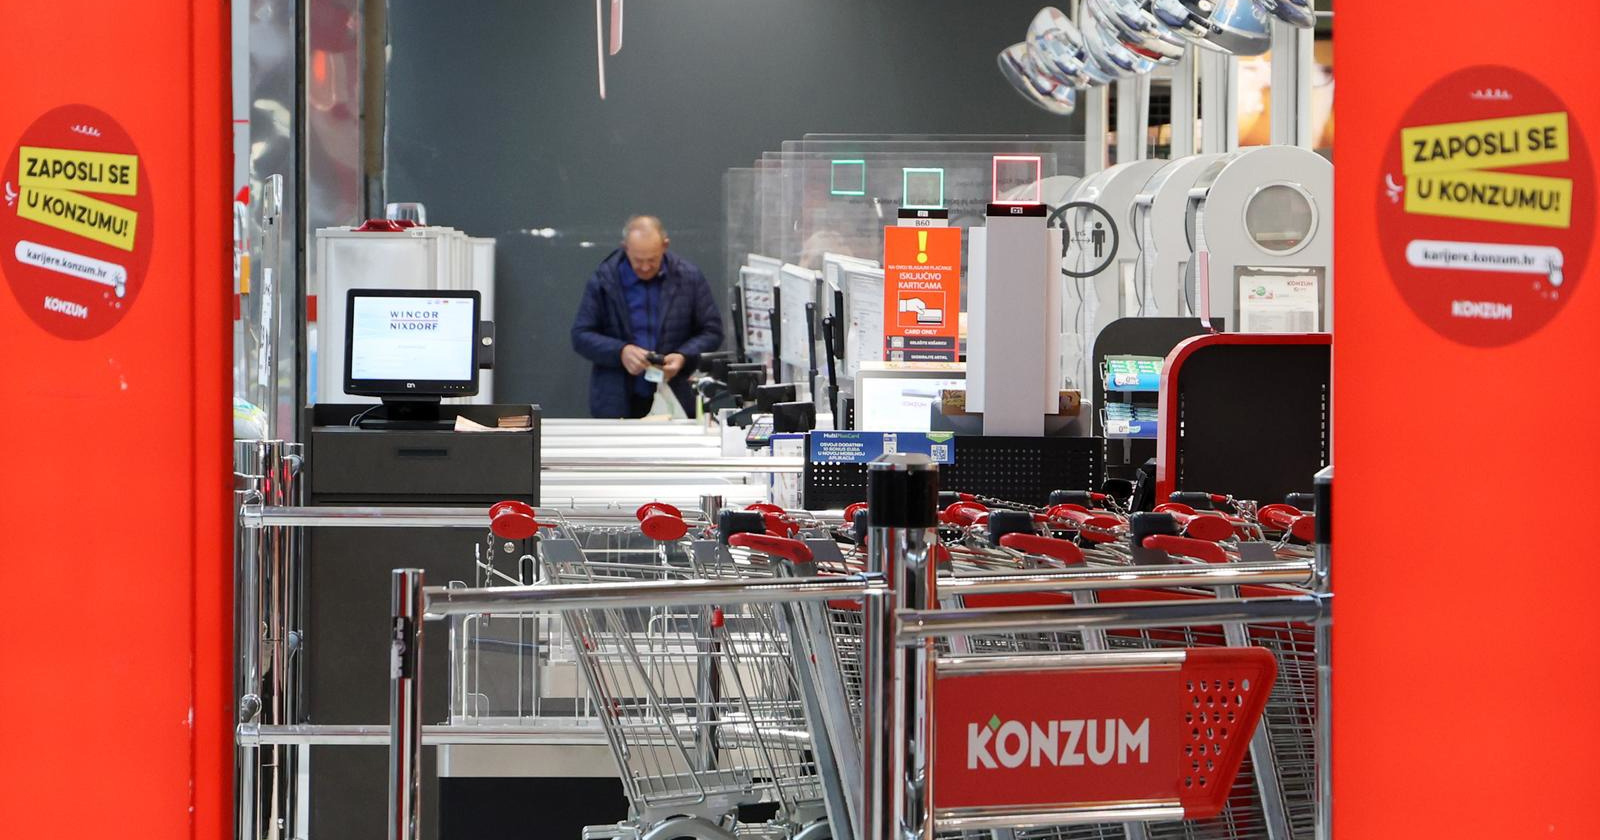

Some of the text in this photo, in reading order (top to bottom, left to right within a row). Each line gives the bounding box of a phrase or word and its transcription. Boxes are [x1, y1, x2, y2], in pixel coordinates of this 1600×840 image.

[1414, 127, 1558, 162] ZAPOSLI SE
[26, 158, 130, 184] ZAPOSLI SE
[1417, 178, 1561, 212] U KONZUMU!
[27, 189, 128, 237] U KONZUMU!
[915, 219, 930, 227] B60
[26, 249, 108, 278] karijere.konzum.hr
[1423, 248, 1536, 266] karijere.konzum.hr
[898, 281, 942, 290] KARTICAMA
[44, 296, 88, 319] KONZUM
[390, 311, 439, 319] WINCOR
[1452, 300, 1512, 320] KONZUM
[390, 323, 439, 331] NIXDORF
[967, 716, 1149, 769] KONZUM
